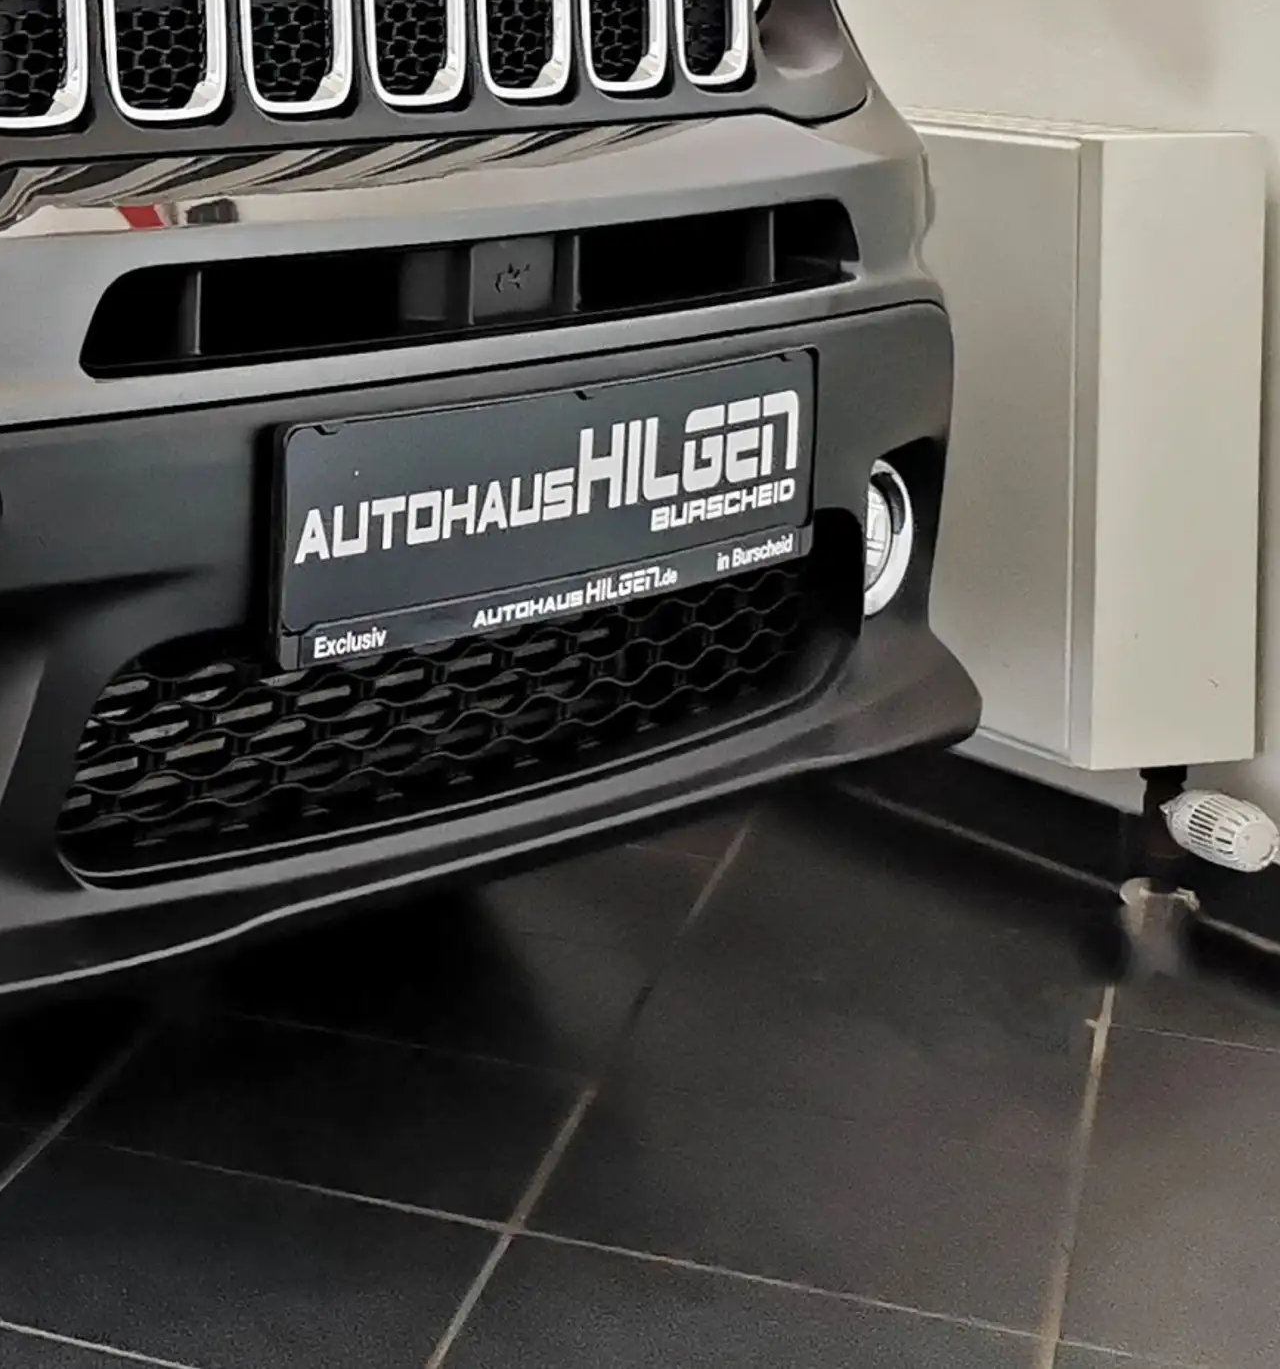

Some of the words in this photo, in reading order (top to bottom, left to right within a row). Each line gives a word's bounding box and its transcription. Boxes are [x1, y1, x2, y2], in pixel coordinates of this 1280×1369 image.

[293, 467, 576, 565] AUTOHAUS
[576, 389, 800, 515] HILGEN
[650, 477, 796, 532] BURSCHEID
[313, 626, 387, 659] Exclusiv
[472, 589, 584, 629] AUTOHAUS
[716, 549, 730, 571] in
[732, 533, 794, 569] Burscheid
